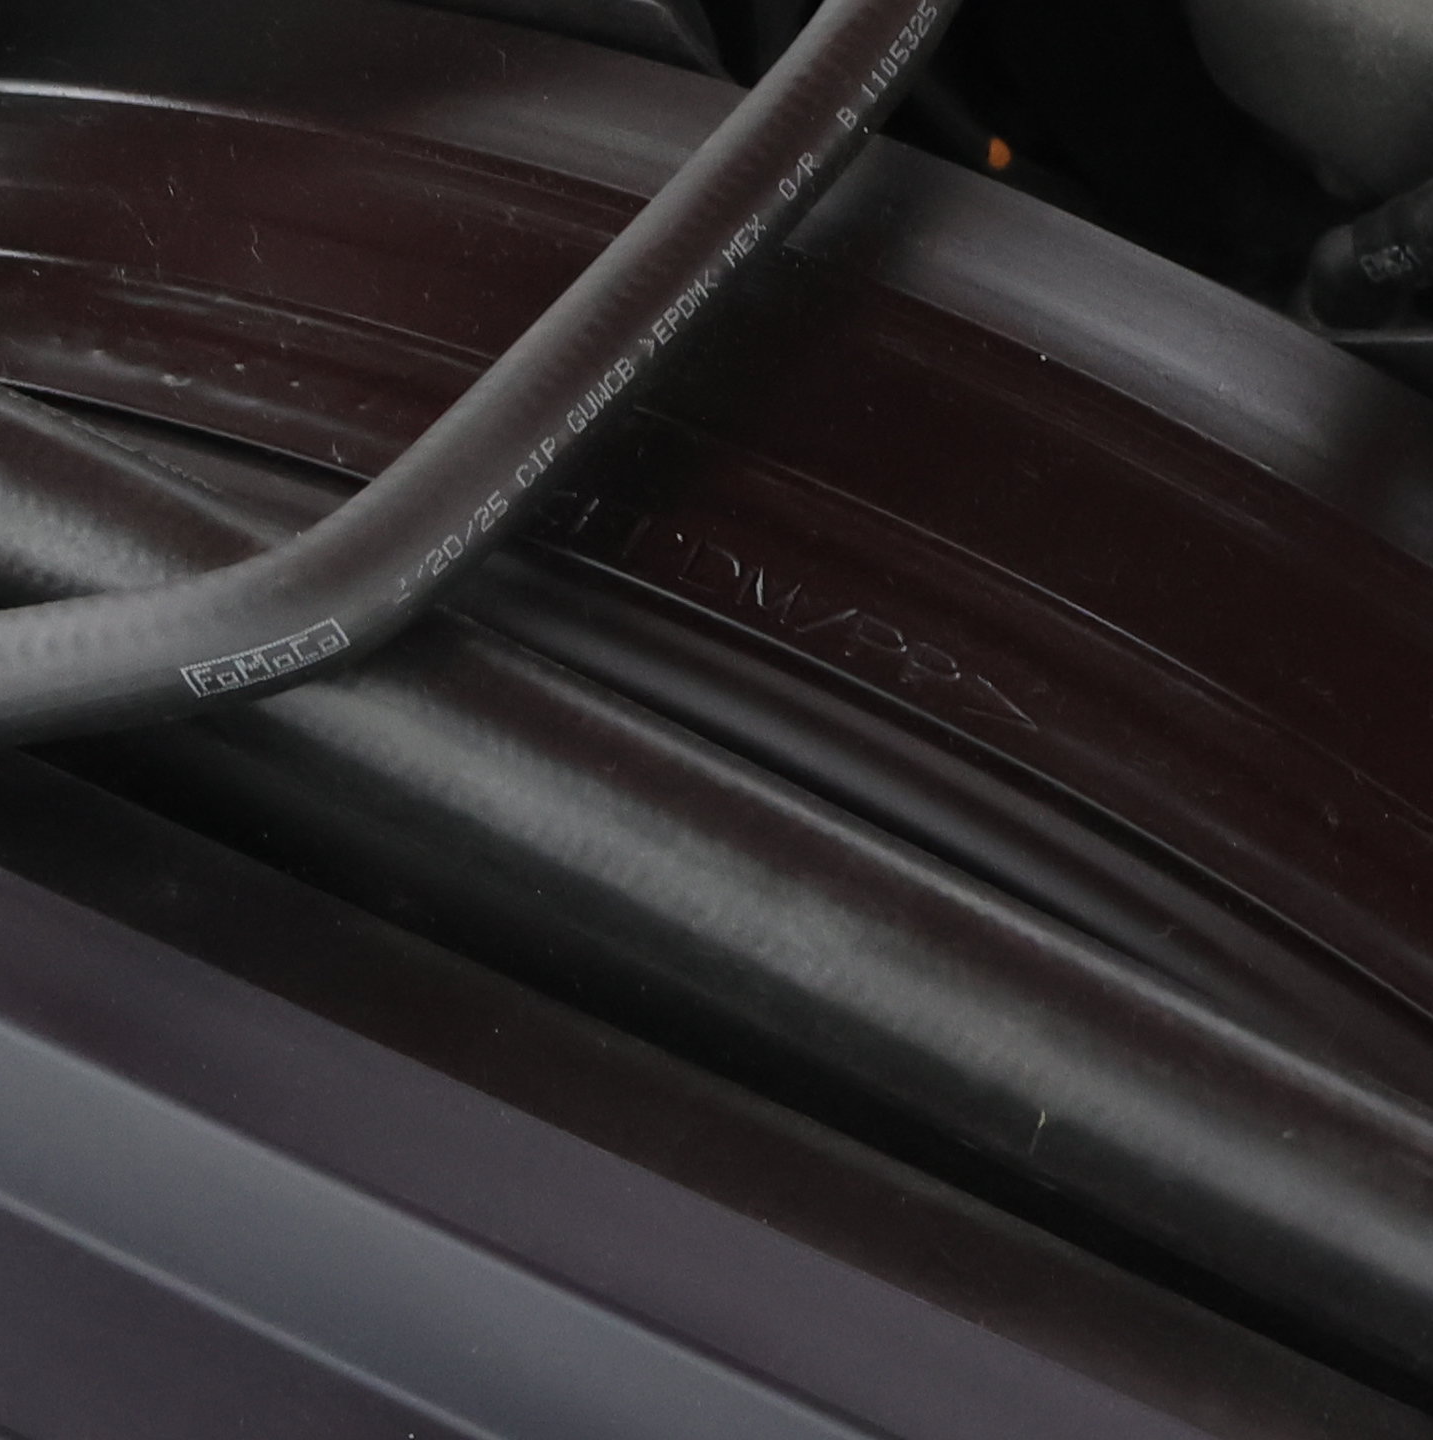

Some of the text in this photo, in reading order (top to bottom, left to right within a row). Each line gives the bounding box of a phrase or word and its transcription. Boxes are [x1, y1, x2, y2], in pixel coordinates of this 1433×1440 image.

[514, 435, 557, 488] CIP
[566, 356, 636, 435] GUWCB
[721, 213, 767, 268] MEX
